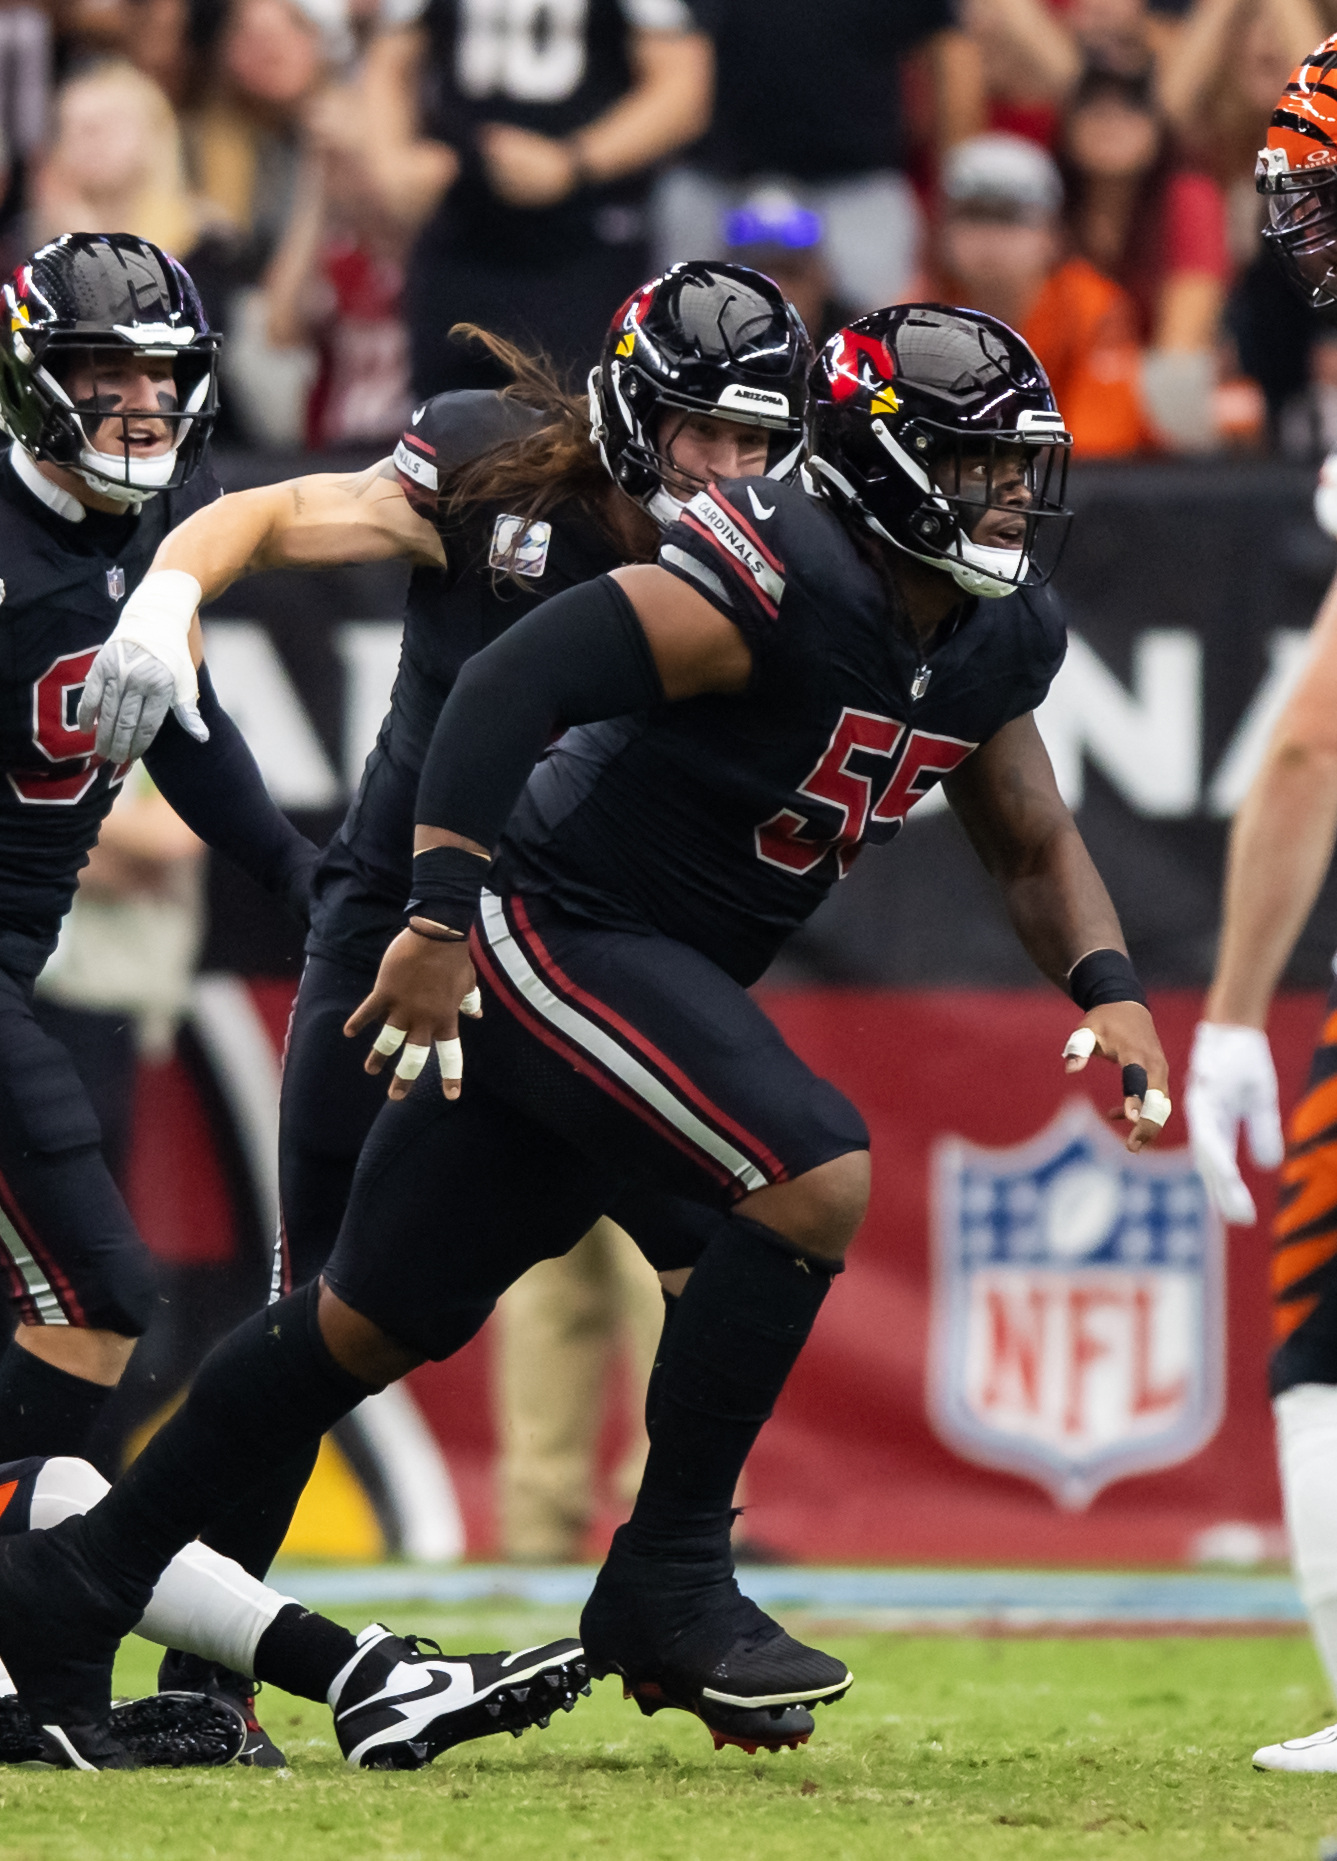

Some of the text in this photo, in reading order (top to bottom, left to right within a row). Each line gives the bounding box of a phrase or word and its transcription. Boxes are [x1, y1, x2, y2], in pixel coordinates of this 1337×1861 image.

[733, 388, 783, 406] ARIZONA
[697, 501, 766, 575] CARDINALS
[5, 644, 142, 806] 9
[753, 706, 981, 881] 55
[981, 1286, 1192, 1434] NFL
